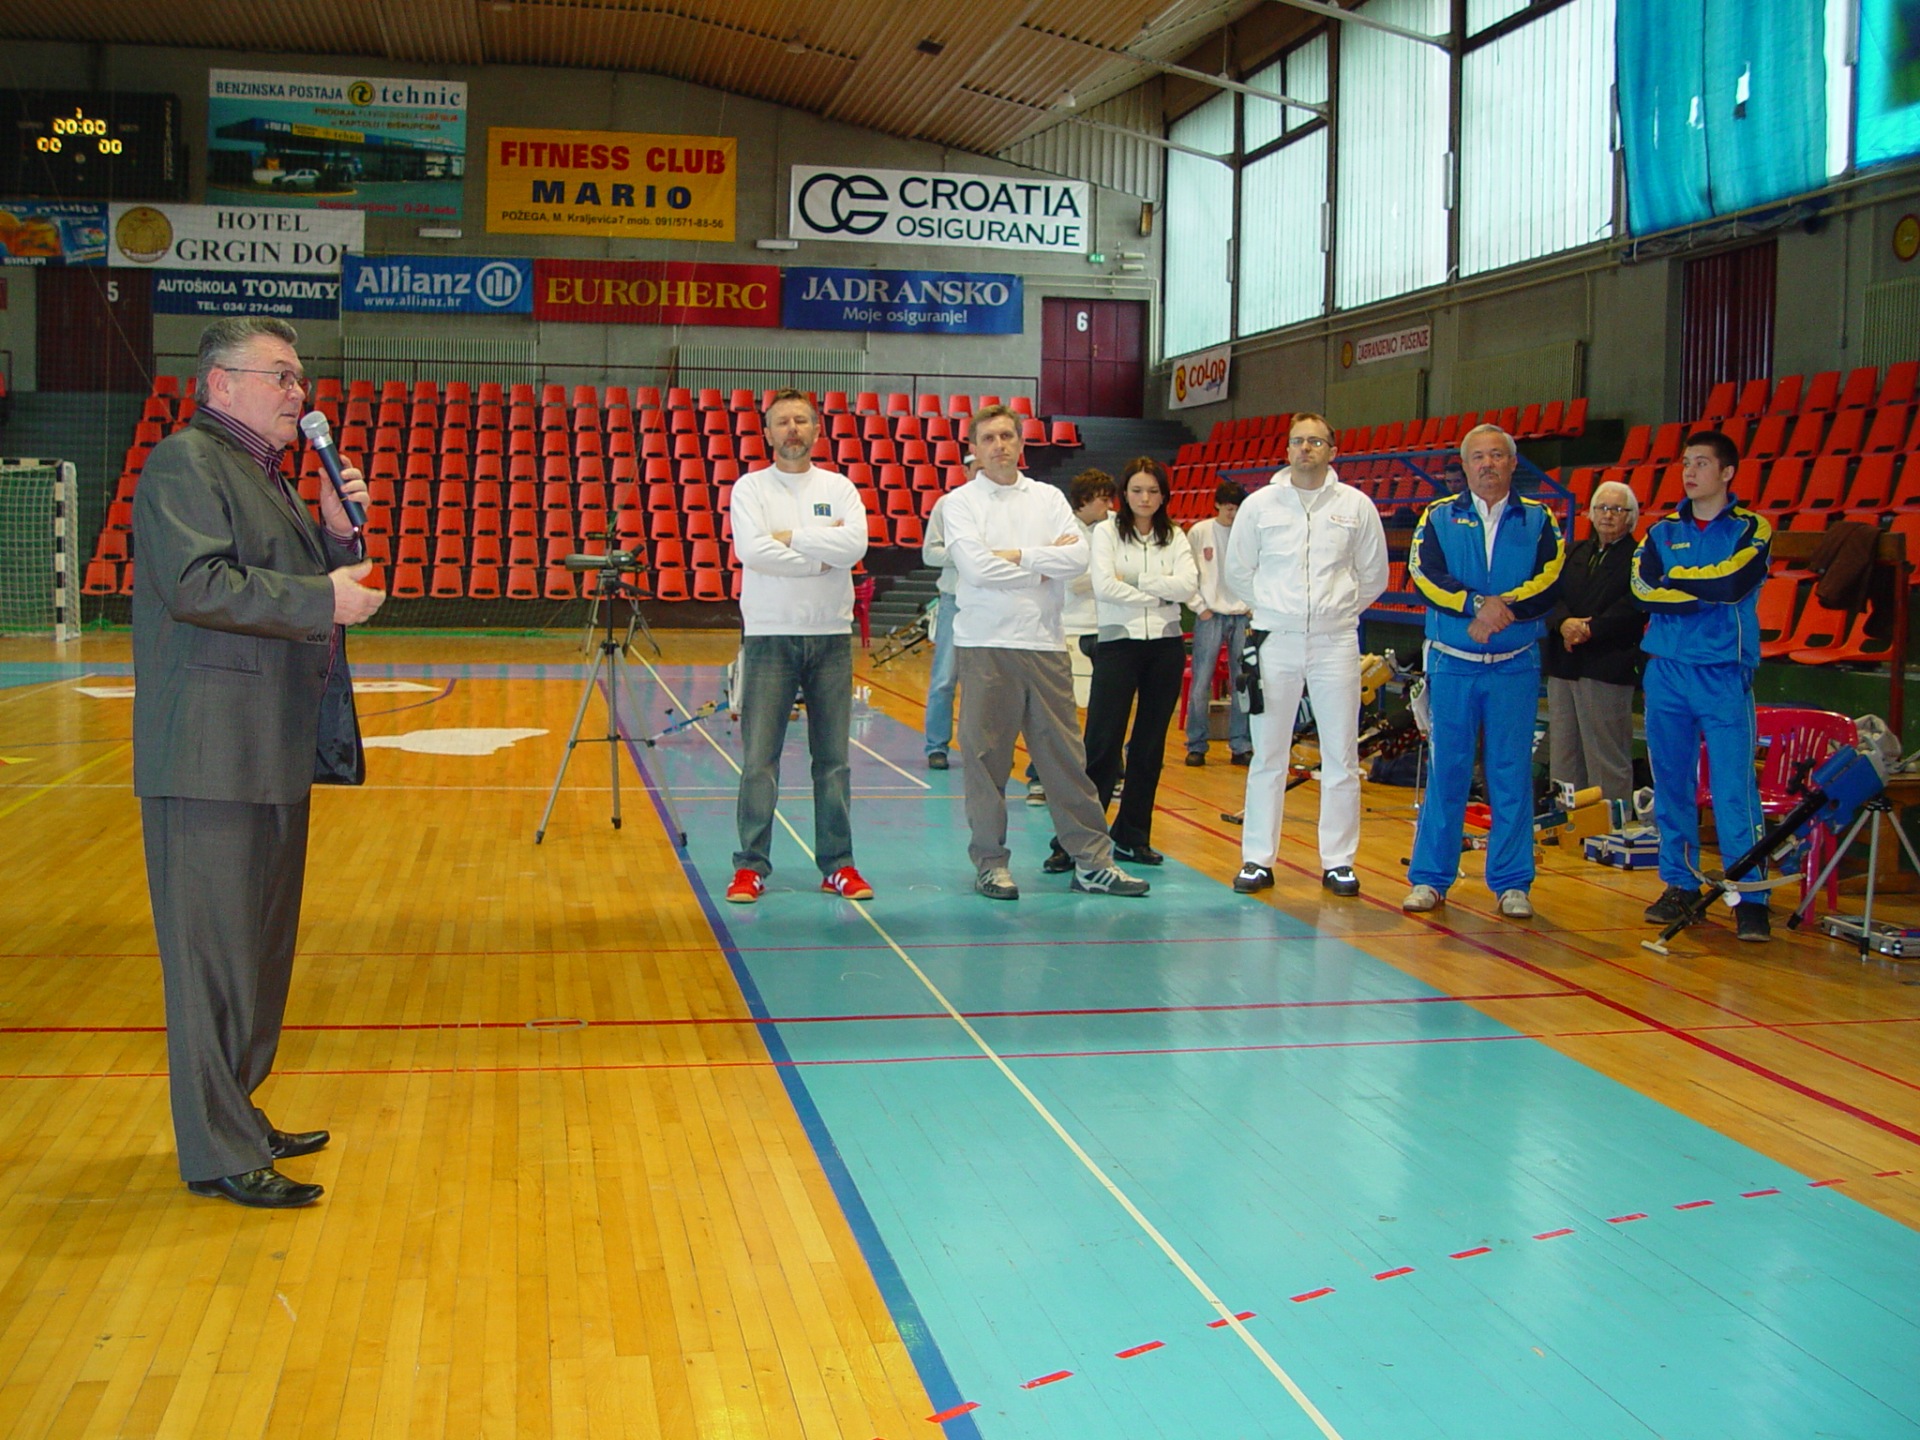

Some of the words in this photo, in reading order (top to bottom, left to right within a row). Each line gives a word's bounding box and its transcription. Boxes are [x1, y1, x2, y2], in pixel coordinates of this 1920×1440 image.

[216, 81, 285, 97] BENZINSKA
[288, 84, 342, 100] POSTAJA
[381, 85, 460, 106] tehnic
[500, 141, 630, 171] FITNESS
[646, 147, 726, 174] CLUB
[532, 180, 692, 209] MARIO
[899, 177, 1081, 218] CROATIA
[217, 211, 310, 233] HOTEL
[502, 209, 549, 222] POŽEGA,
[553, 212, 565, 222] M.
[627, 216, 652, 226] mob.
[897, 215, 1081, 247] OSIGURANJE
[176, 238, 281, 264] GRGIN
[107, 281, 119, 302] 5
[157, 277, 238, 295] AUTOŠKOLA
[242, 279, 341, 300] TOMMY
[355, 265, 471, 295] Allianz
[802, 276, 1010, 307] JADRANSKO
[197, 300, 220, 311] TEL:
[223, 302, 246, 312] 034/
[364, 294, 462, 308] www.allianz.hr
[546, 277, 768, 311] EUROHERC
[843, 306, 882, 324] Moje
[887, 309, 968, 327] osiguranje!
[1076, 311, 1088, 332] 6
